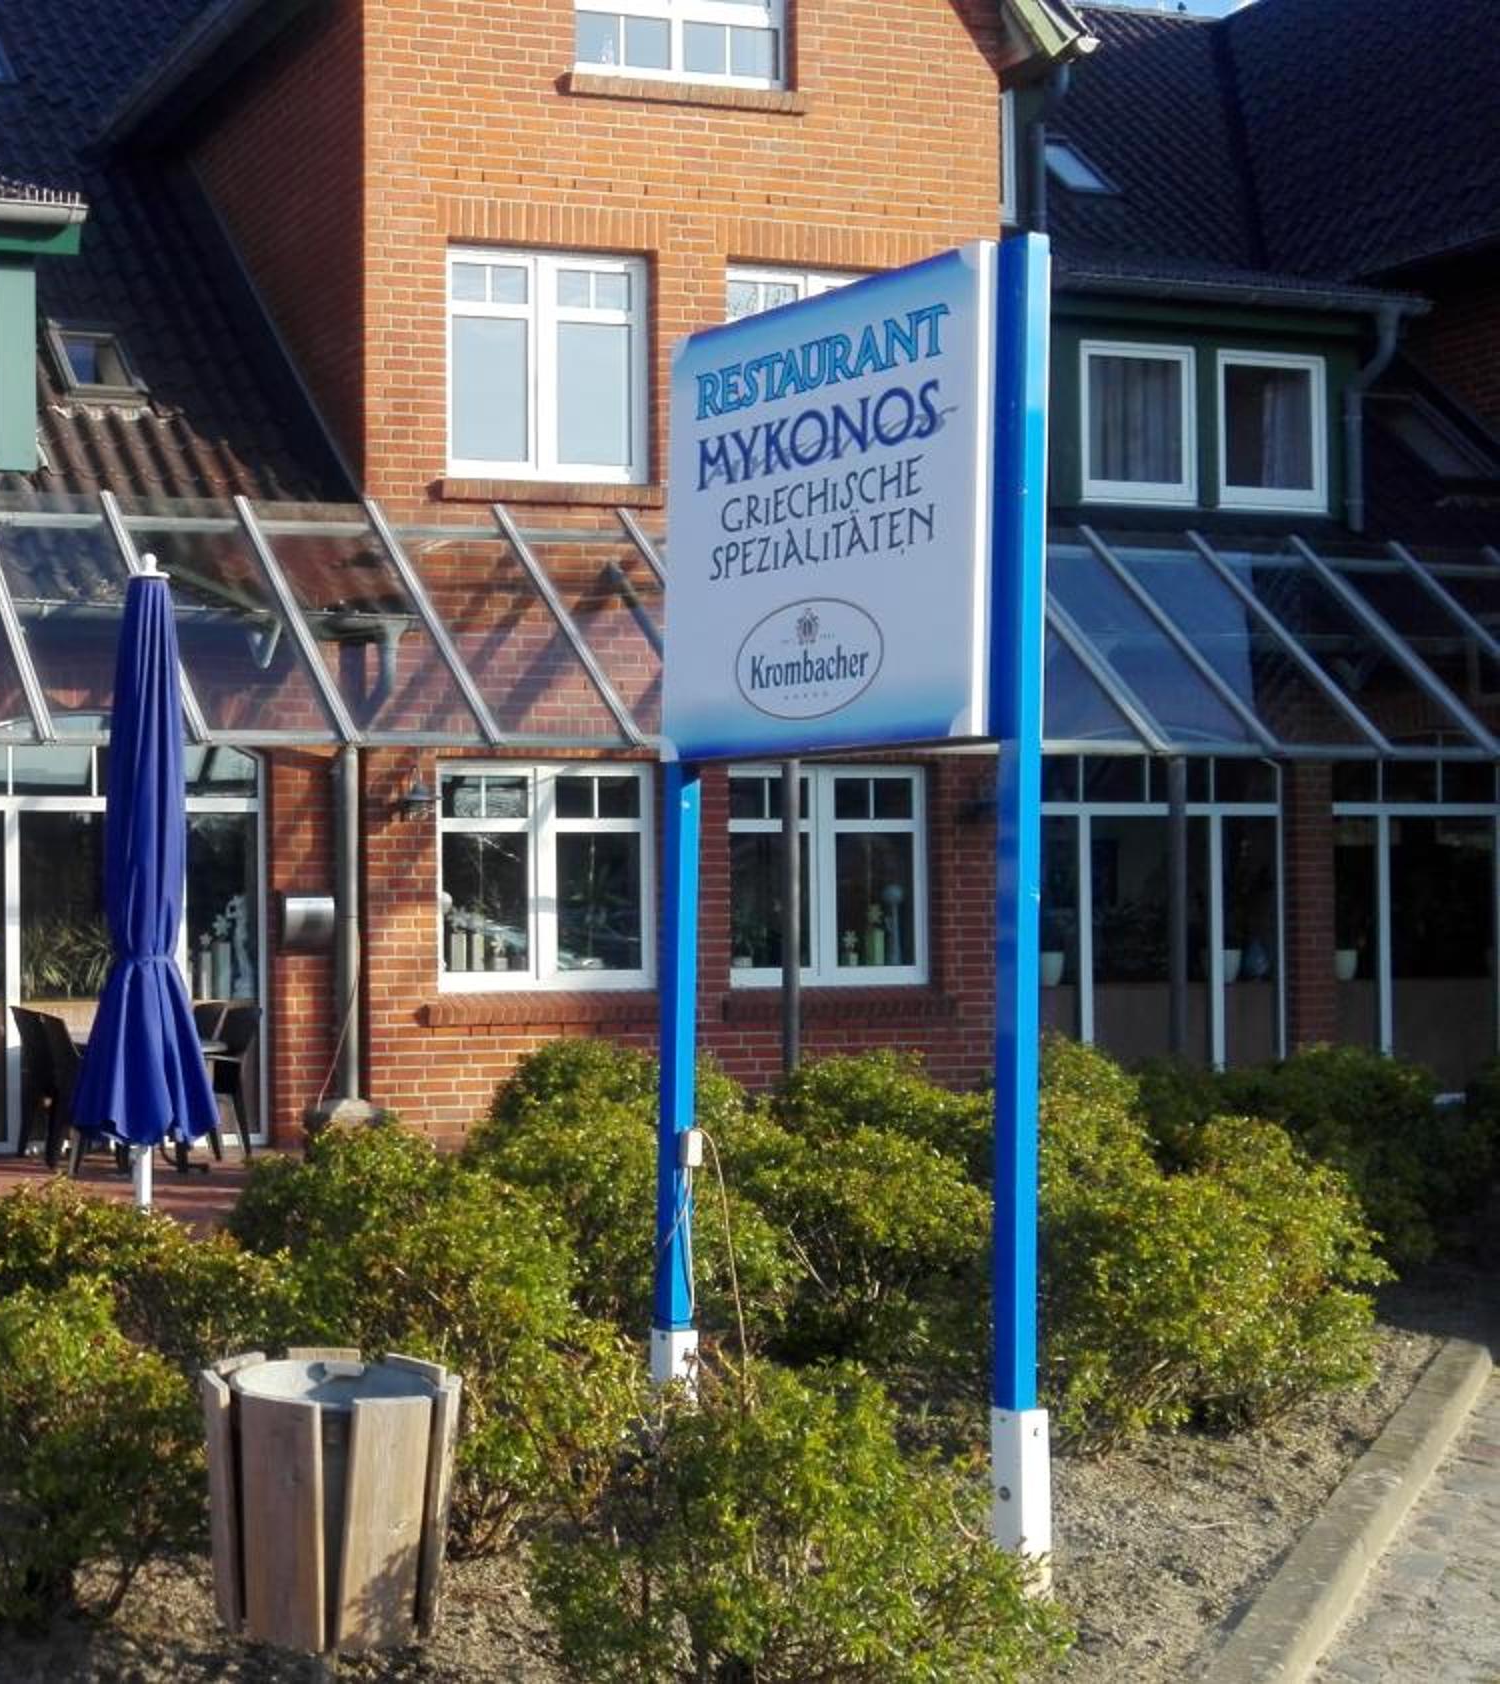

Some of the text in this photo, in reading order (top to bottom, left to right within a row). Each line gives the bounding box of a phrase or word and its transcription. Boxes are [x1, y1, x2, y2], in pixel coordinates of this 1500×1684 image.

[695, 303, 951, 421] RESTAURANT
[697, 378, 941, 491] MYKONOS
[721, 454, 925, 533] GRIECHISCHE
[709, 504, 935, 581] SPEZIALITÄTEN
[751, 643, 870, 690] Krombacher
